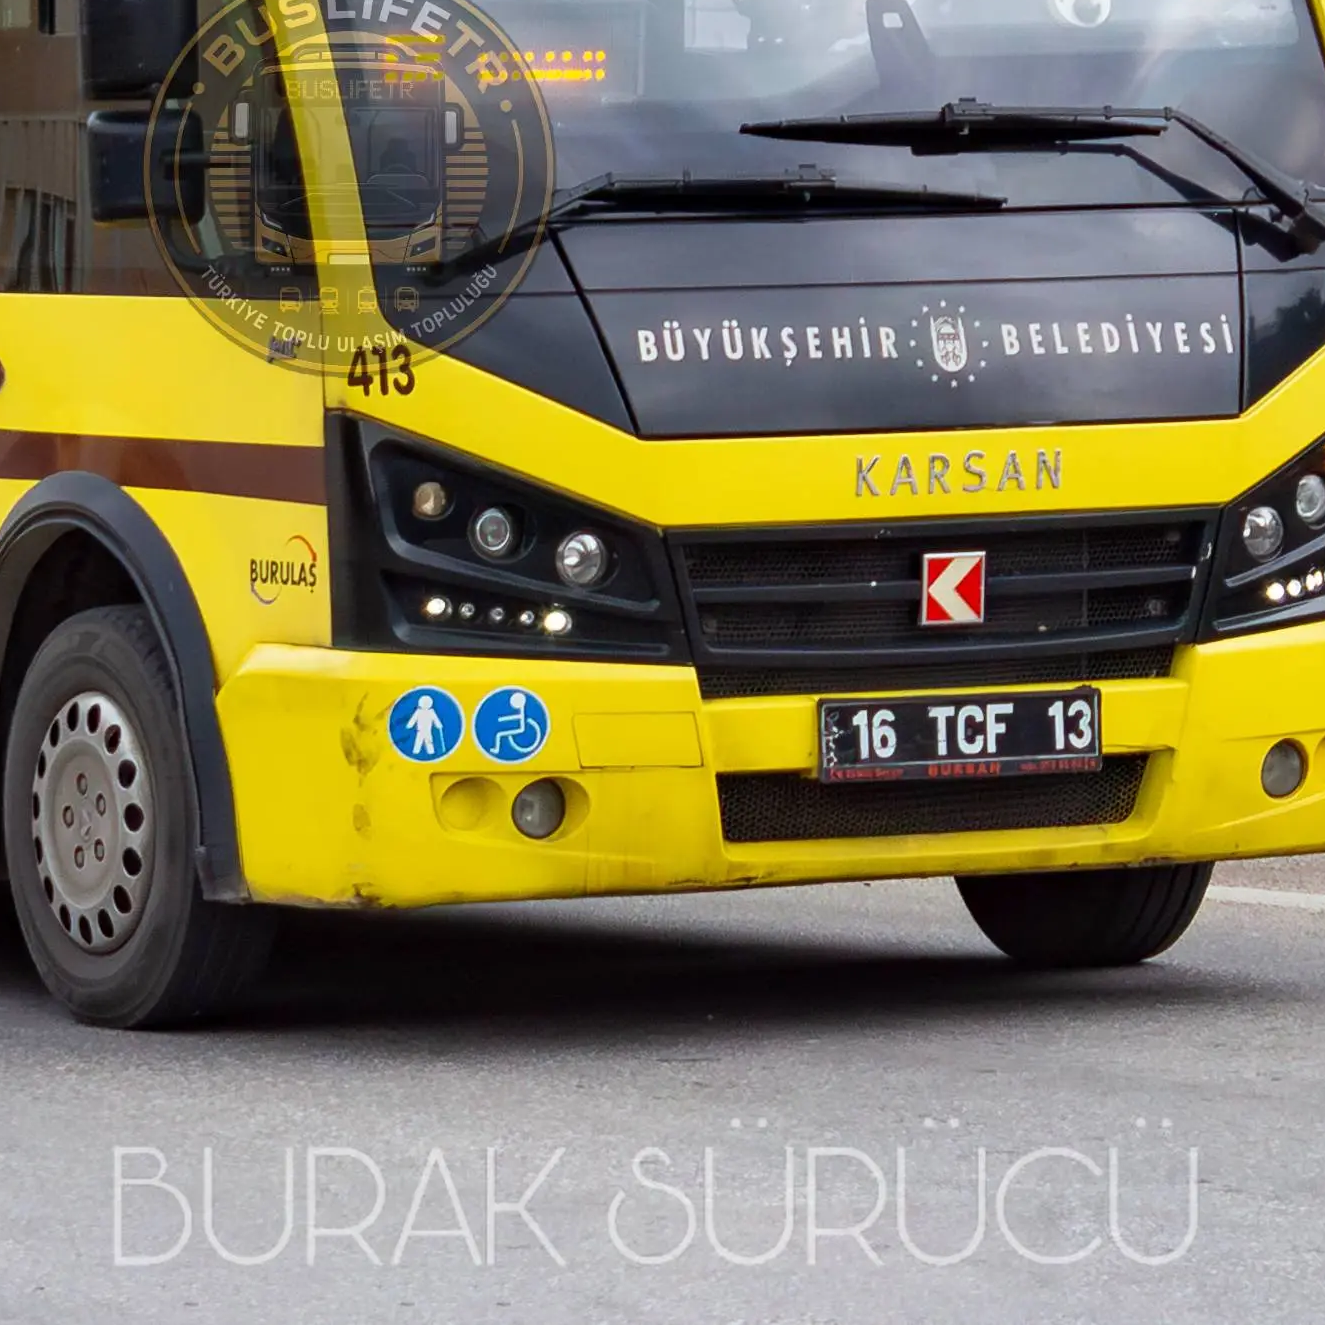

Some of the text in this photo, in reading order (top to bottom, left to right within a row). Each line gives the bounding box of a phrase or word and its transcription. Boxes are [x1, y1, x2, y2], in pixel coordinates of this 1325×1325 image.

[637, 313, 1234, 366] BÜYÜKŞEHİR BELEDİYESİ
[348, 344, 415, 397] 413
[855, 448, 1062, 497] KARSAN
[250, 558, 317, 593] BURULAŞ
[852, 700, 1092, 760] 16 TCF 13
